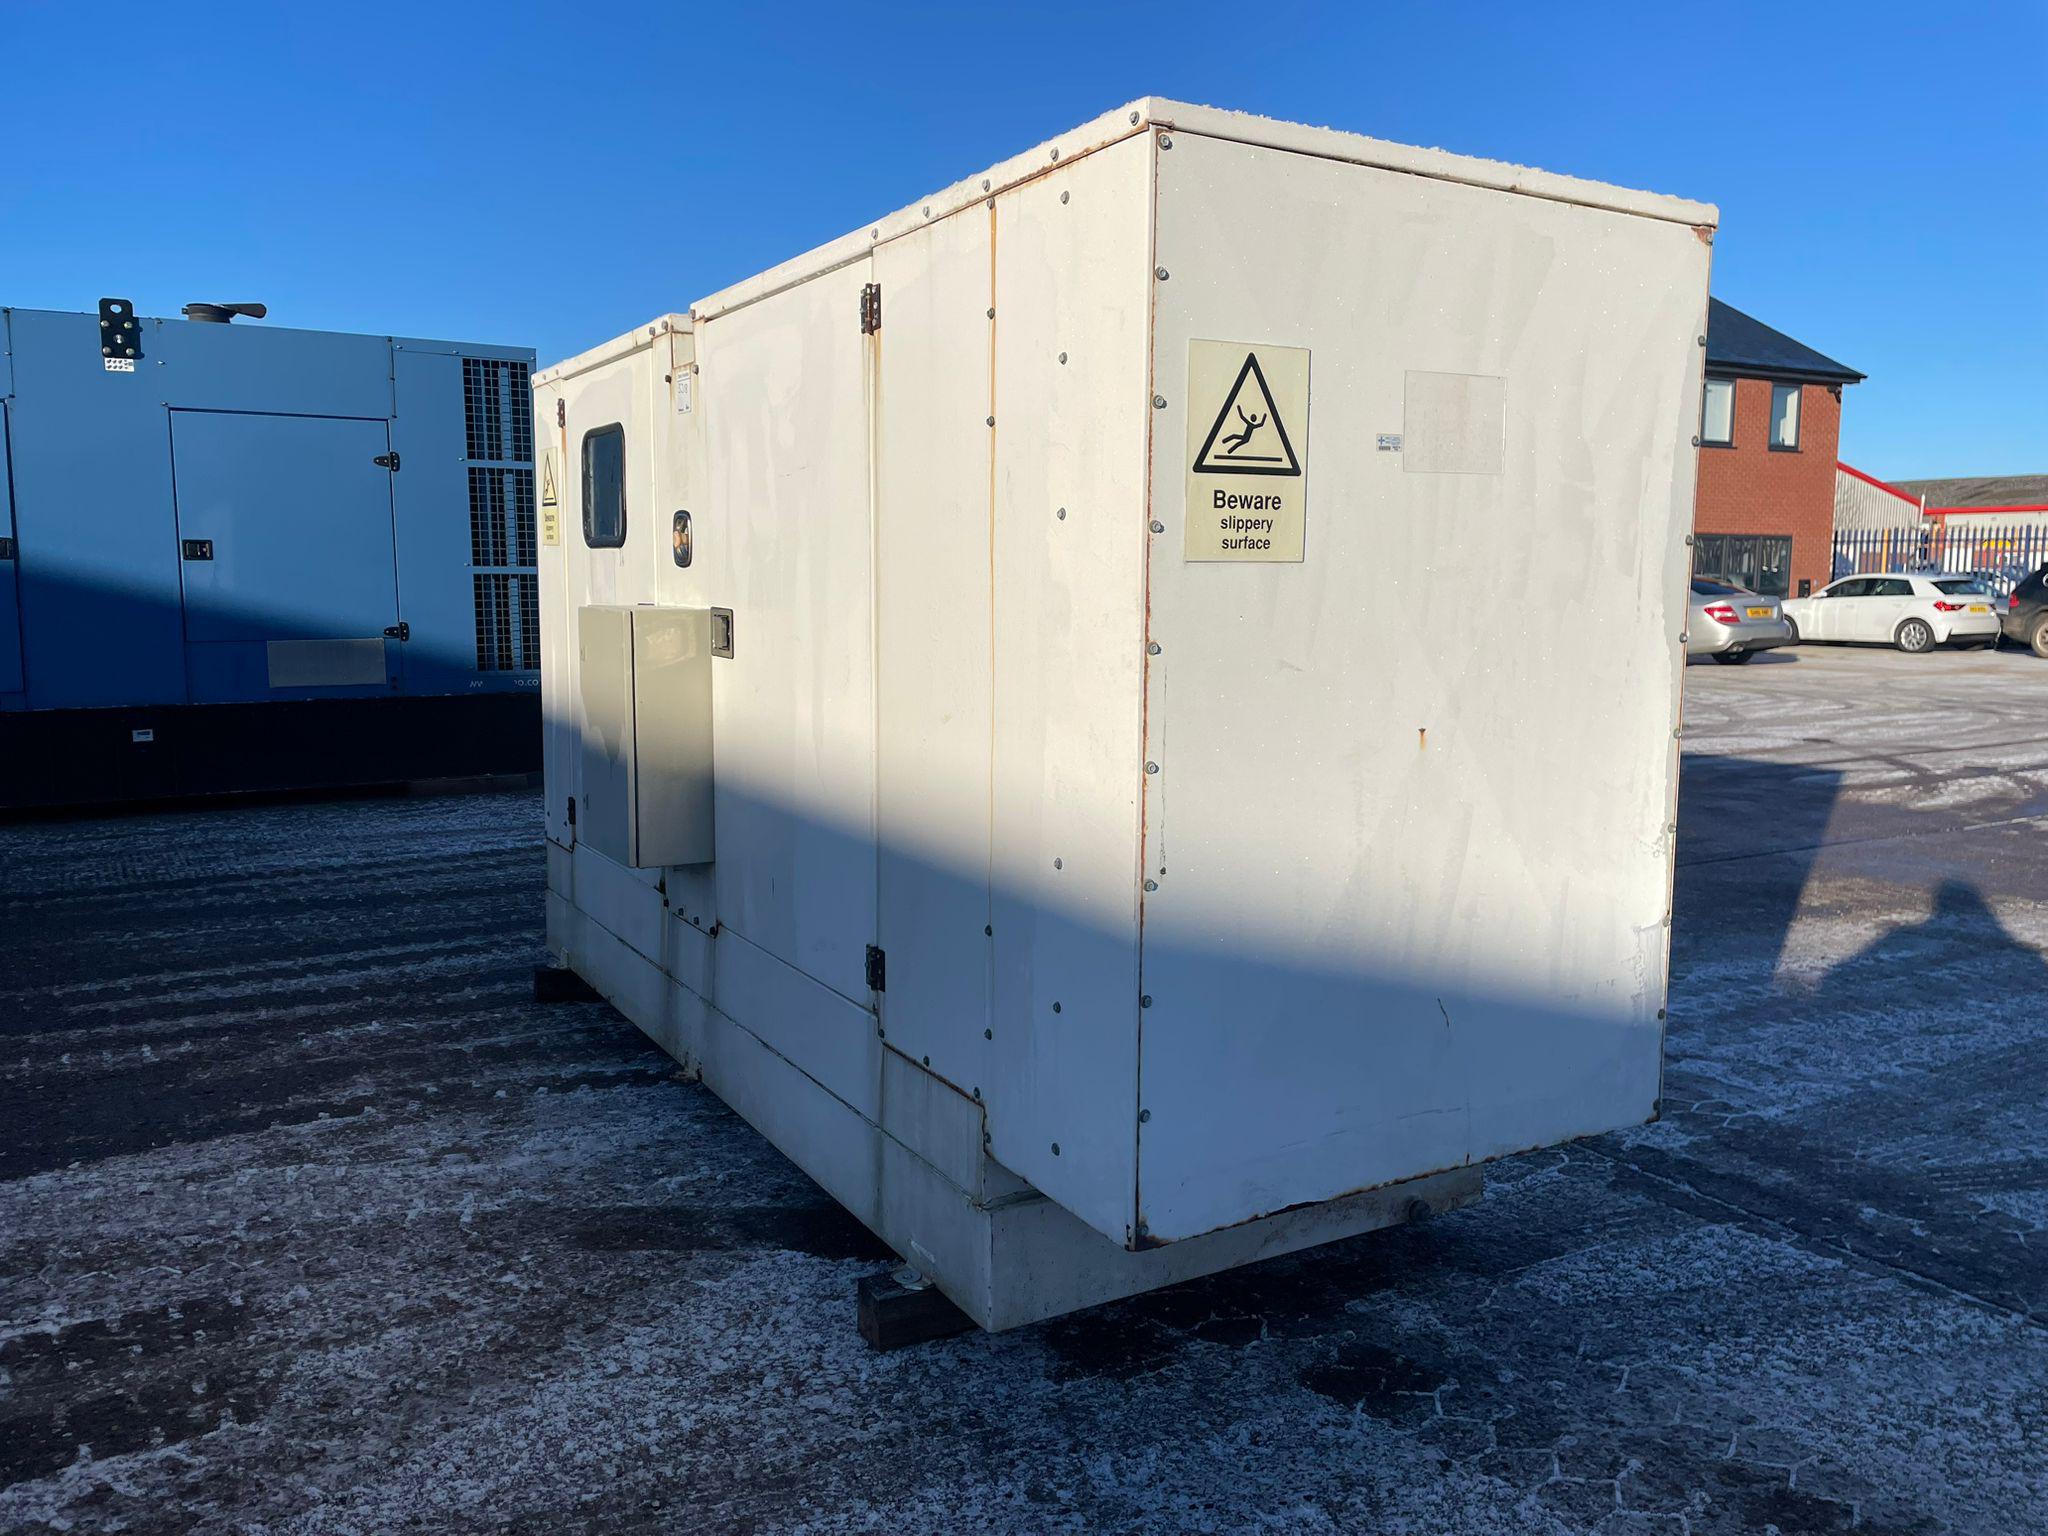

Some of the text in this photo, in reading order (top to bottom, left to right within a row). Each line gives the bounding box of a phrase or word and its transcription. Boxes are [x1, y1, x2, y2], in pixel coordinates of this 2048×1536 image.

[1213, 489, 1282, 511] Beware
[1220, 515, 1274, 533] slippery
[1221, 535, 1271, 550] surface
